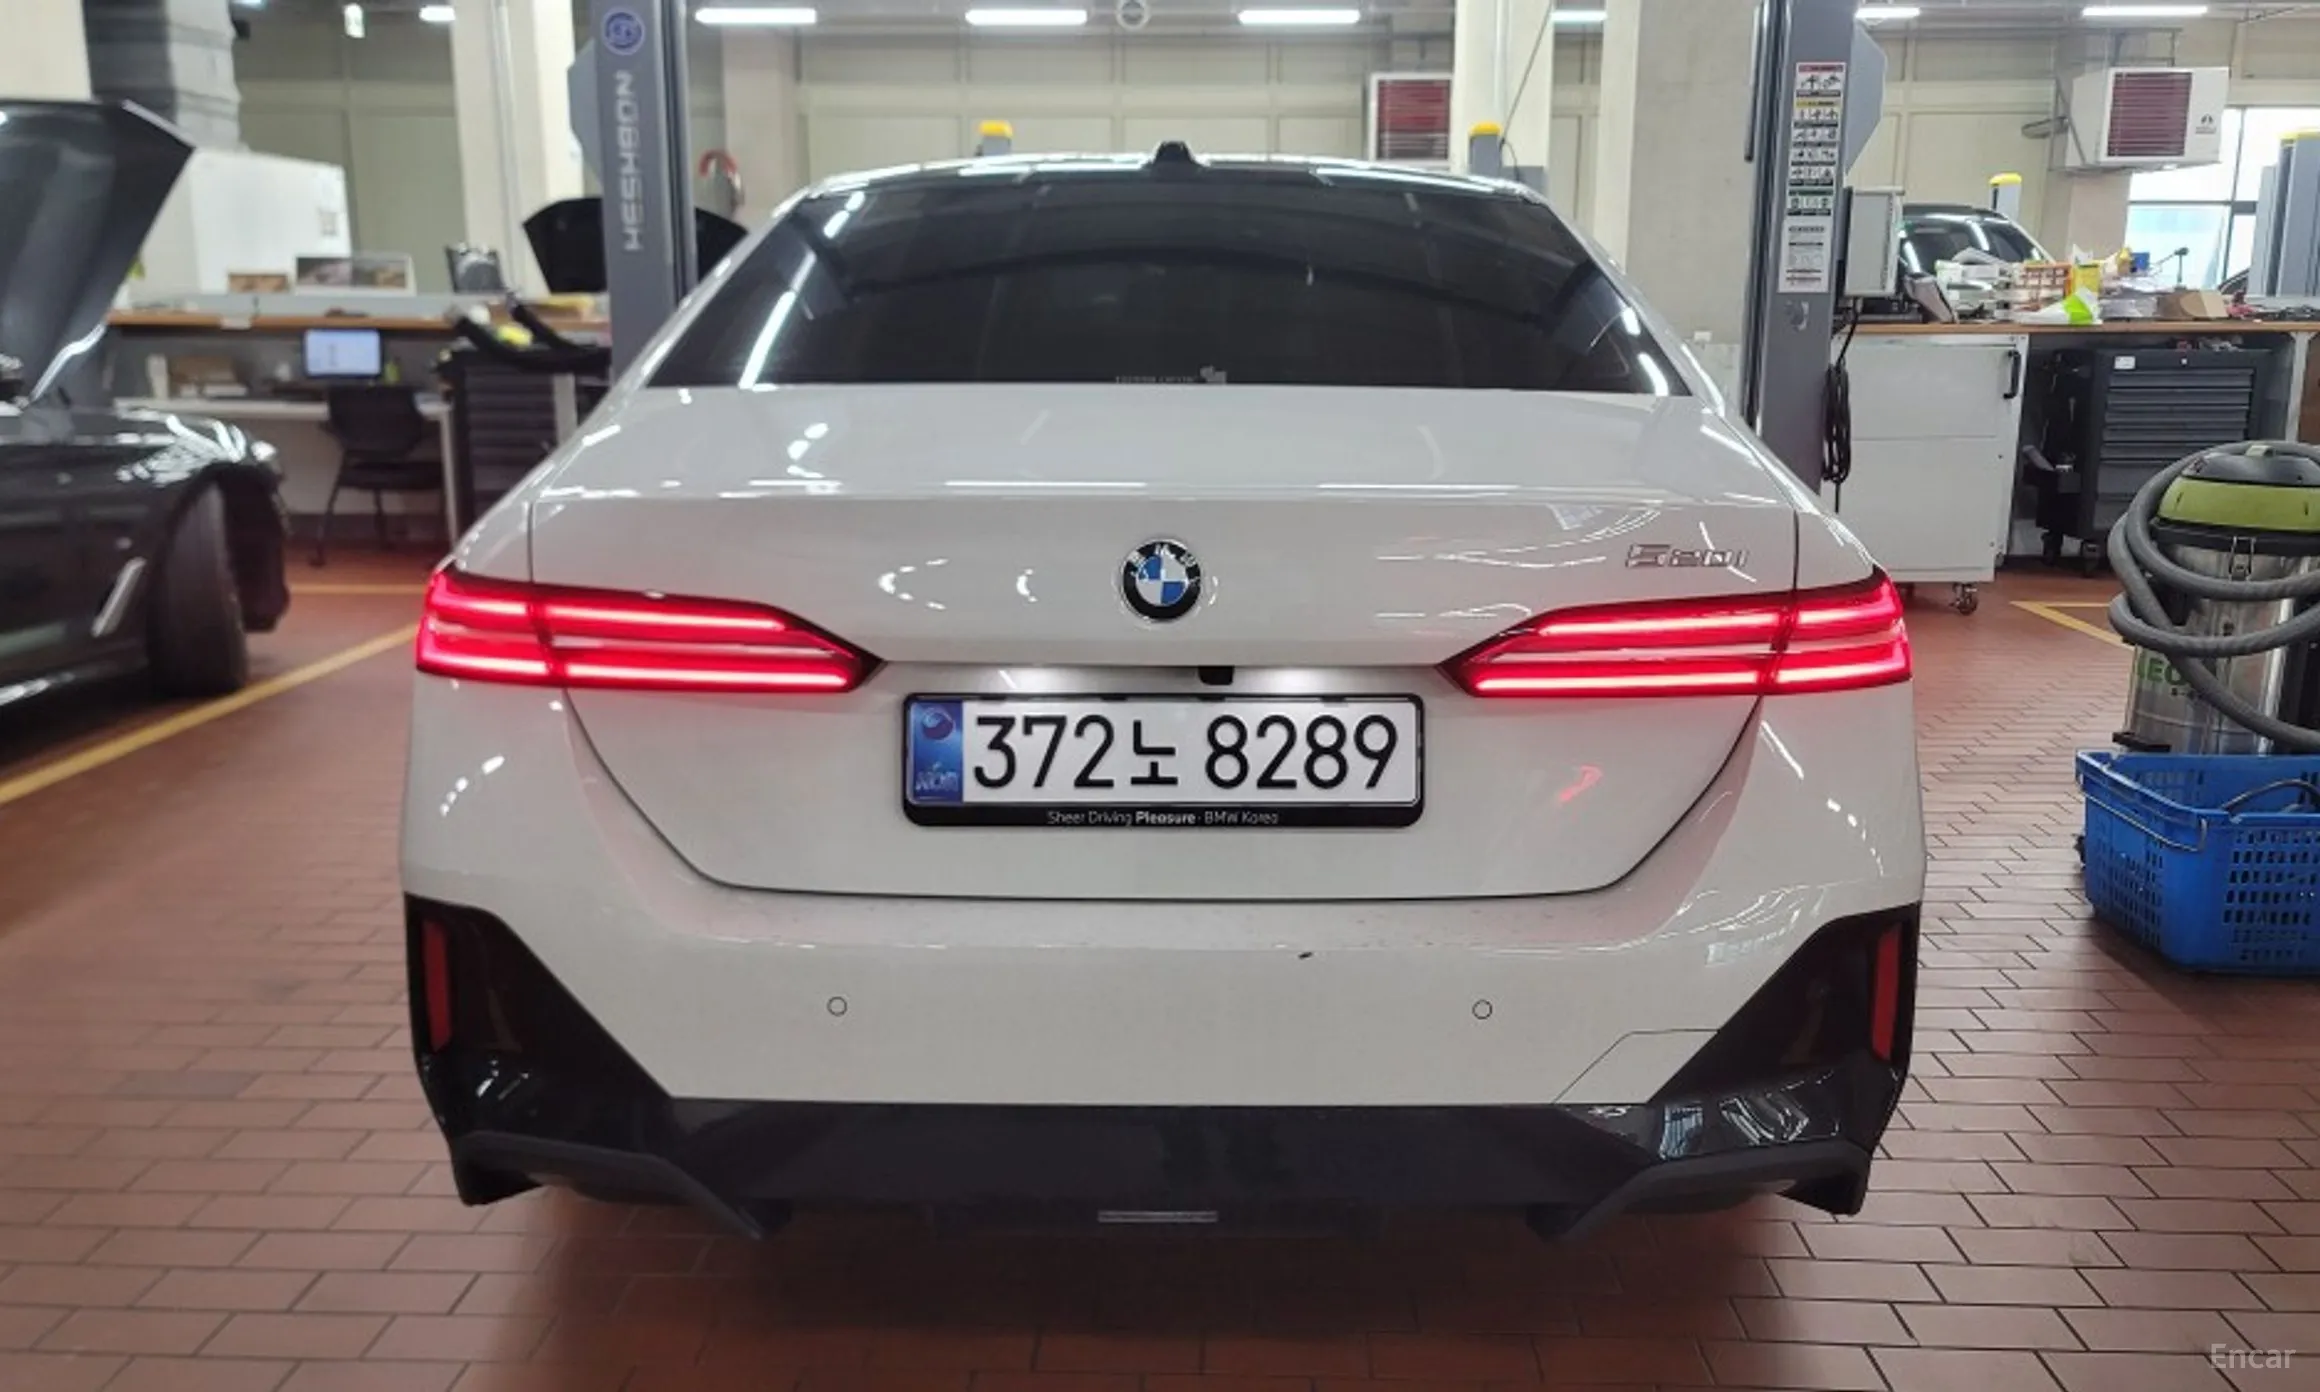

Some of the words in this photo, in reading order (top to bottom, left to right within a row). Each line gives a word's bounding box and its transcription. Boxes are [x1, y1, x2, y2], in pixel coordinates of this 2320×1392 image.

[614, 69, 643, 251] HESHBON
[973, 713, 1179, 789] 372노
[1204, 713, 1399, 789] 8289
[1047, 810, 1085, 825] Sheer
[1088, 810, 1132, 828] Driving
[1135, 810, 1196, 825] Pleasure
[1204, 810, 1238, 825] BMW
[1241, 810, 1279, 825] Korea
